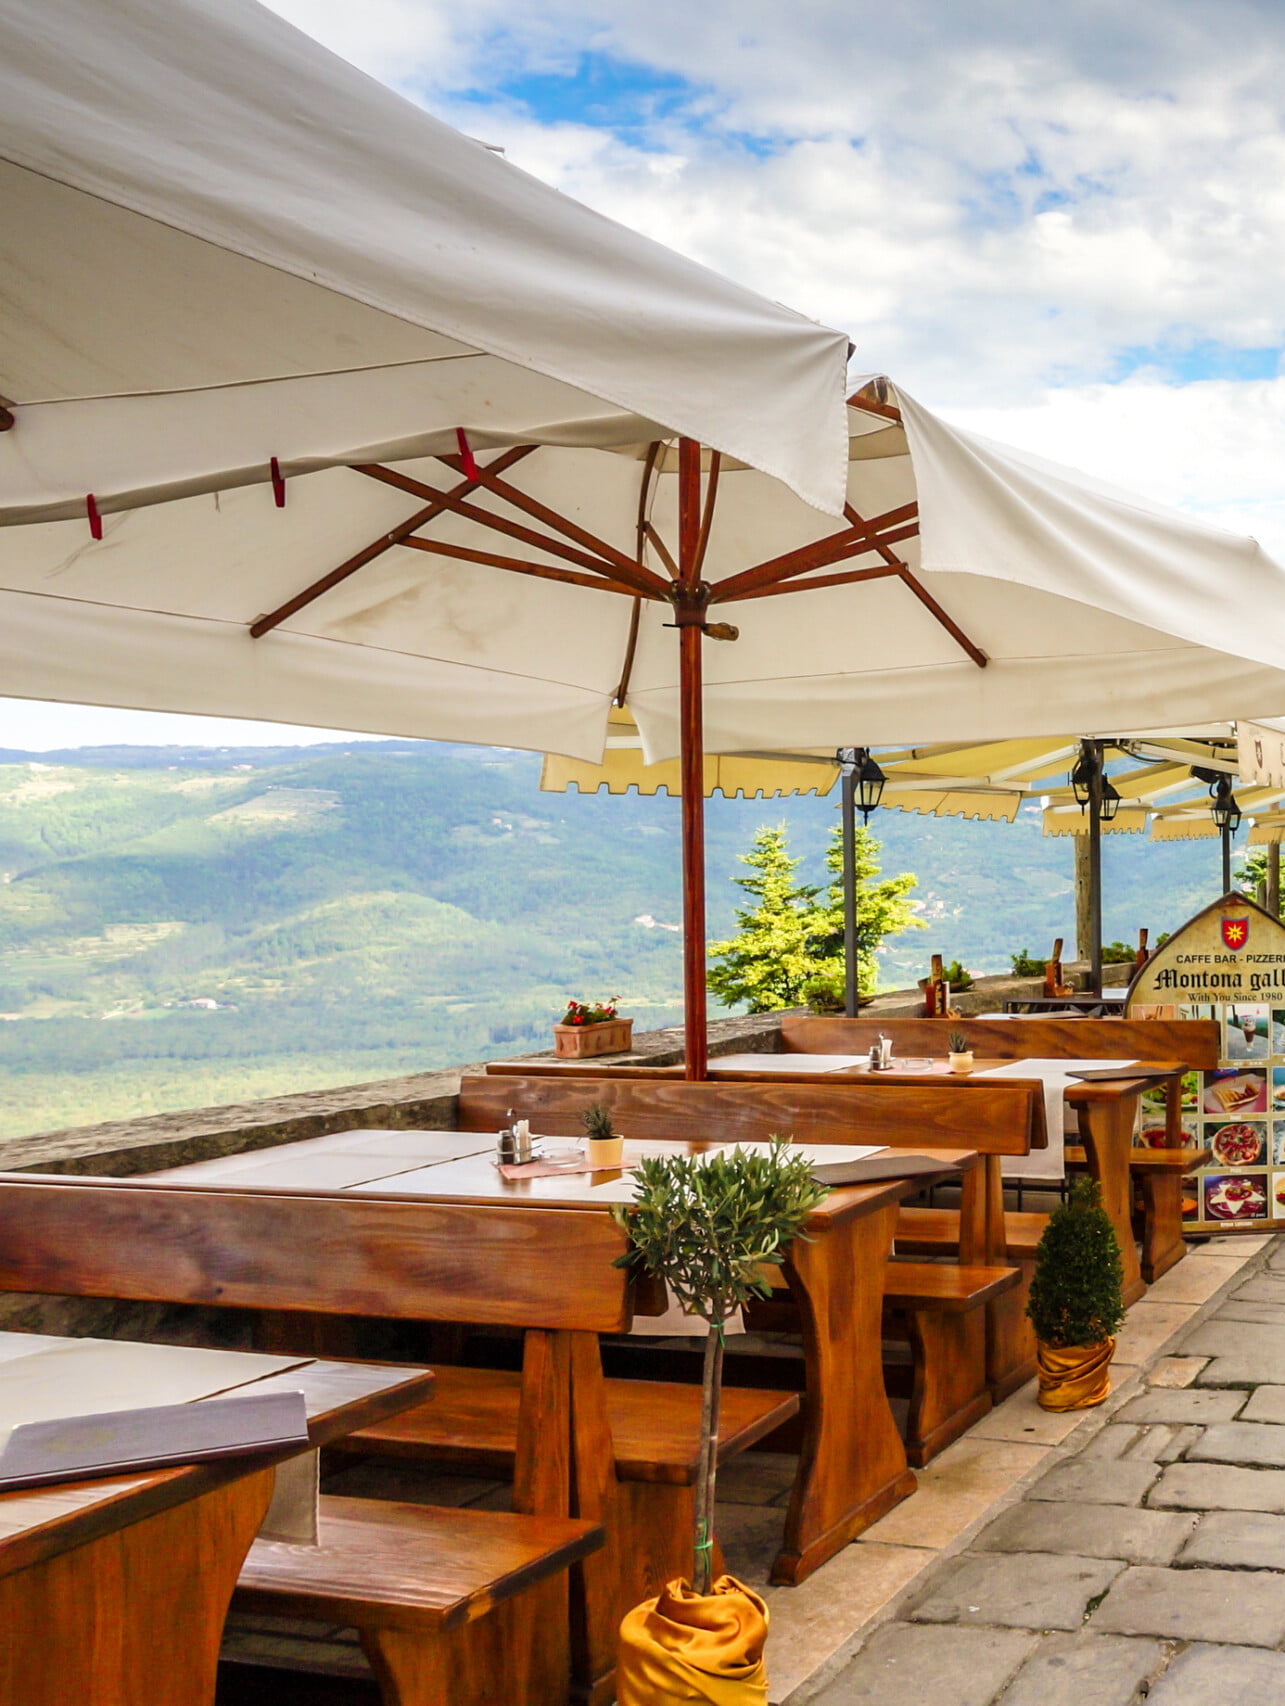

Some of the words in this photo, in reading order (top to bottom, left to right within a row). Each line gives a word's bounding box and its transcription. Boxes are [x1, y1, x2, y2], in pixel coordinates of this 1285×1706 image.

[1176, 954, 1211, 964] CAFFE
[1214, 954, 1237, 964] BAR
[1153, 968, 1242, 990] Montona
[1188, 993, 1210, 1002] With
[1213, 993, 1232, 1002] You
[1233, 993, 1257, 1002] Since
[1260, 992, 1283, 1001] 1980
